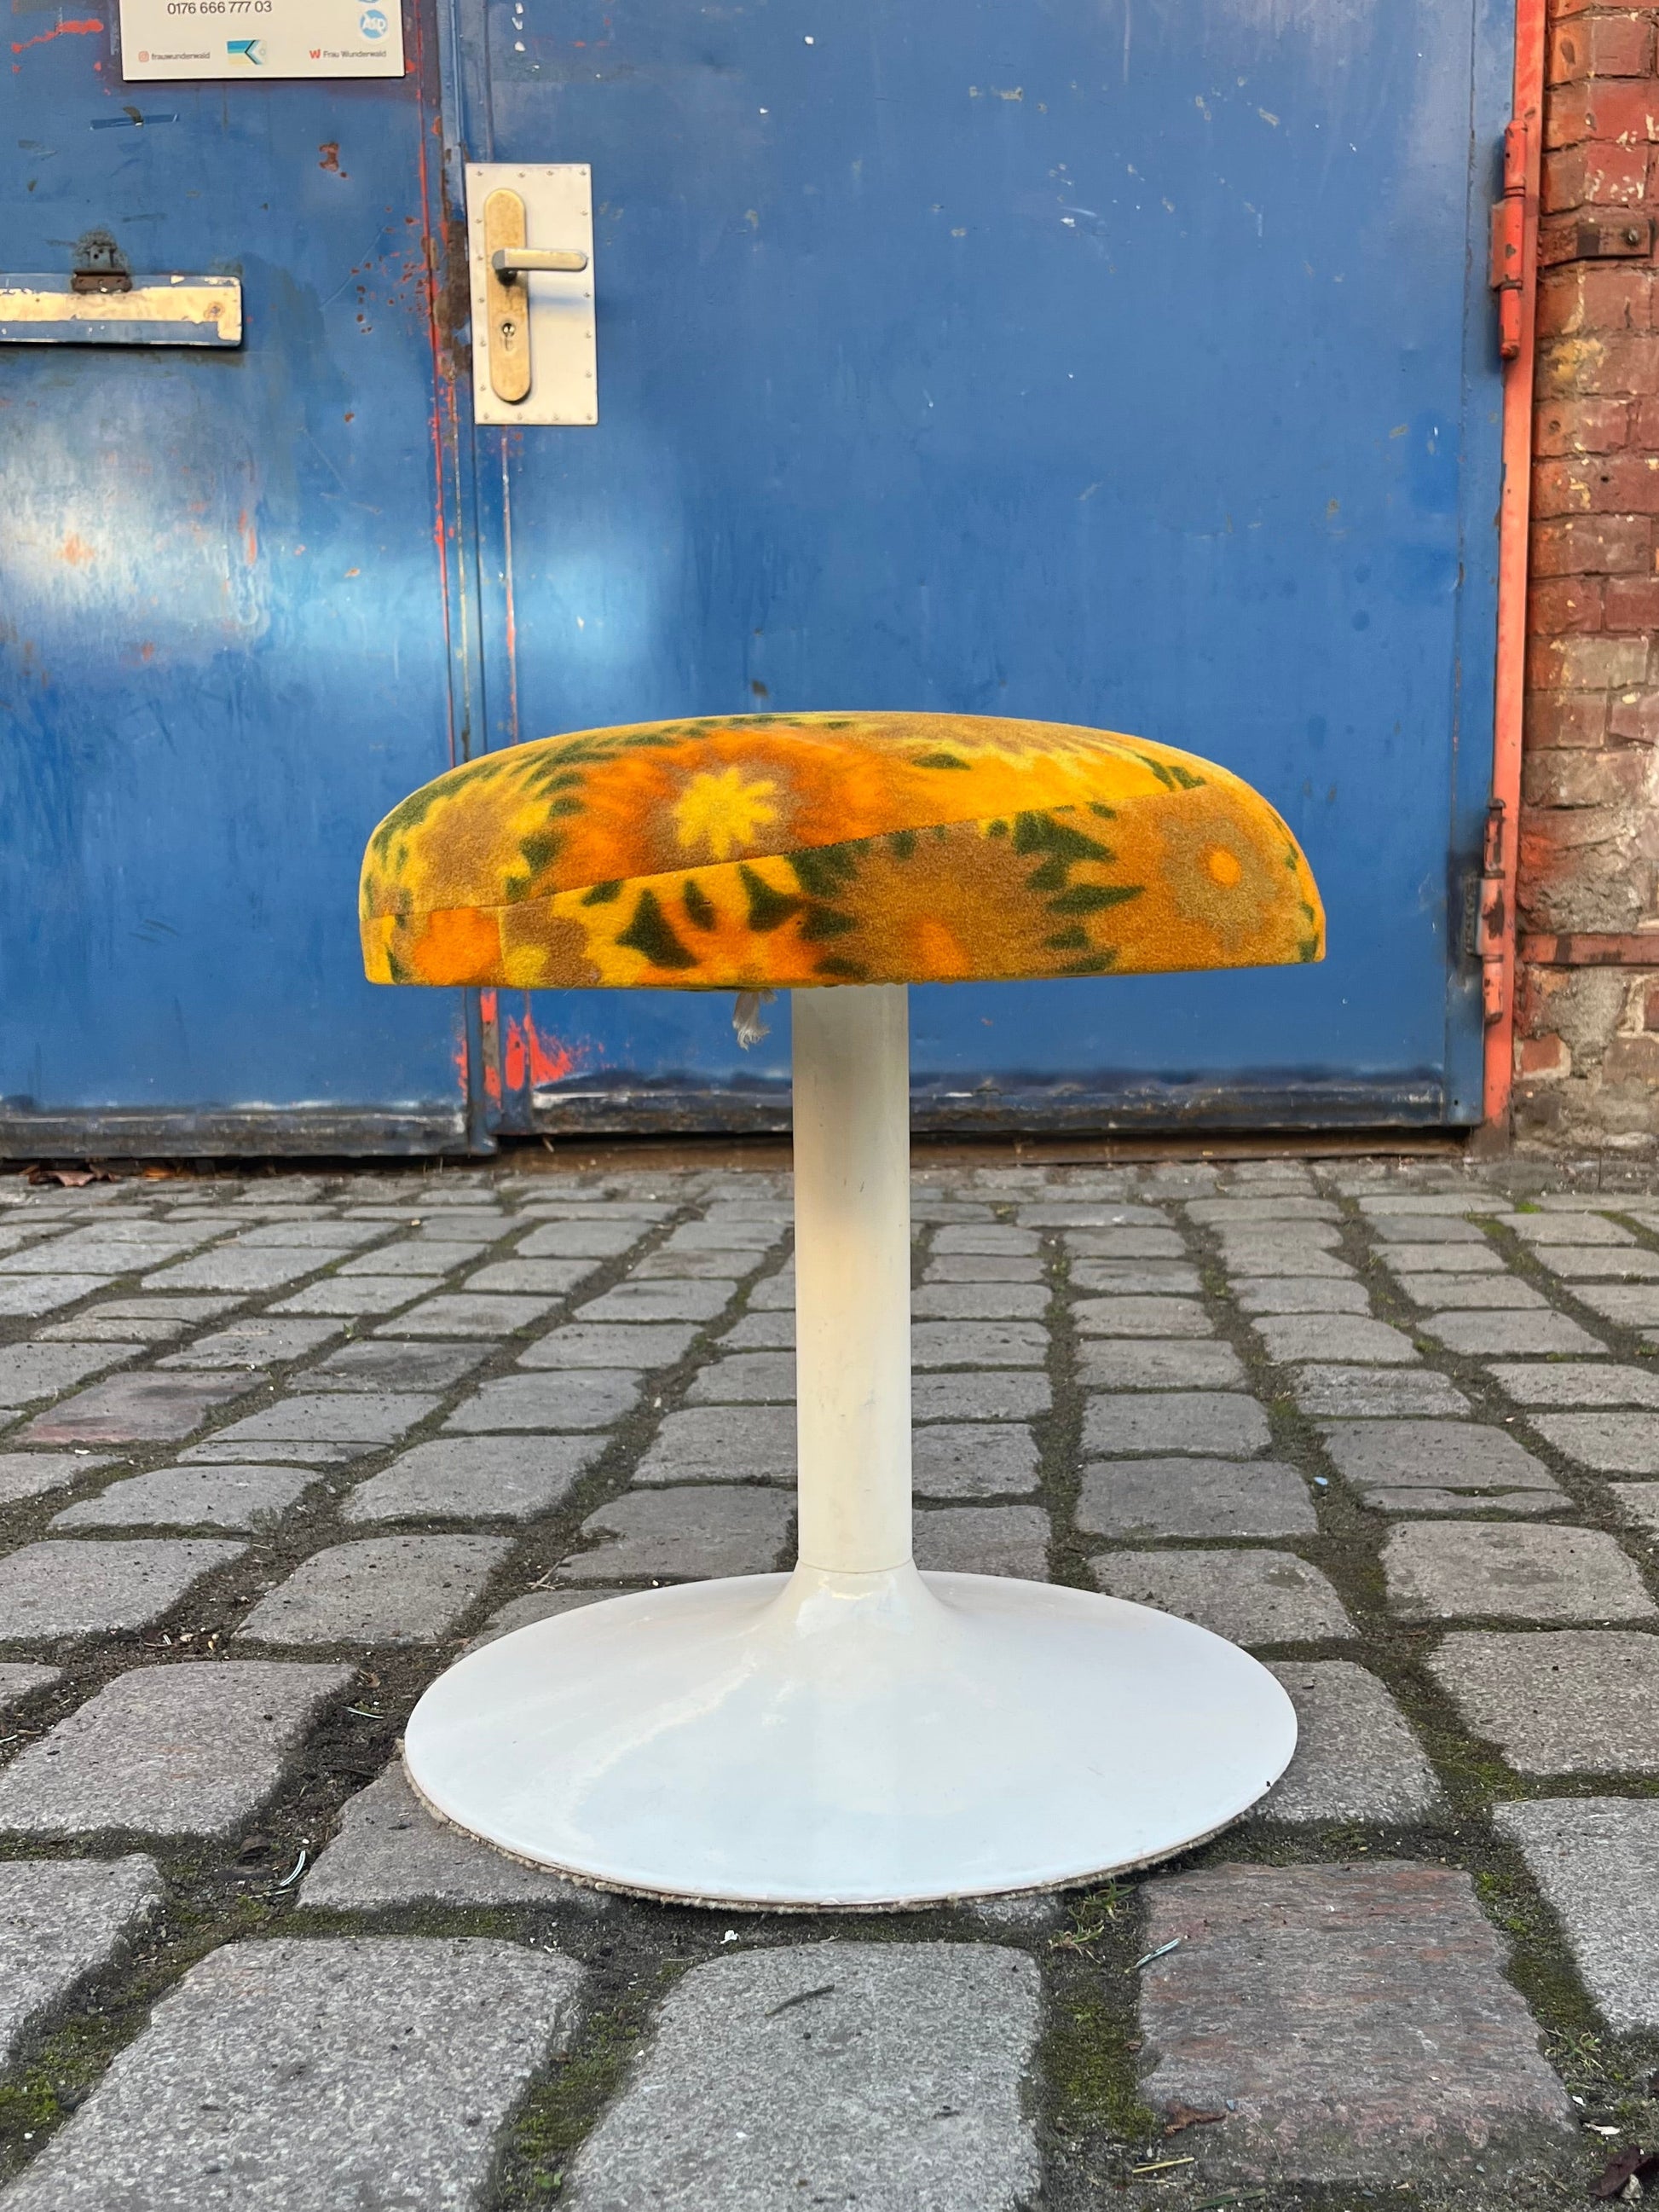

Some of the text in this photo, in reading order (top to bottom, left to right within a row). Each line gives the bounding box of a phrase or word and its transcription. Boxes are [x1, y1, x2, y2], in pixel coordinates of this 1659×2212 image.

[167, 0, 272, 14] 0176 666 777 03
